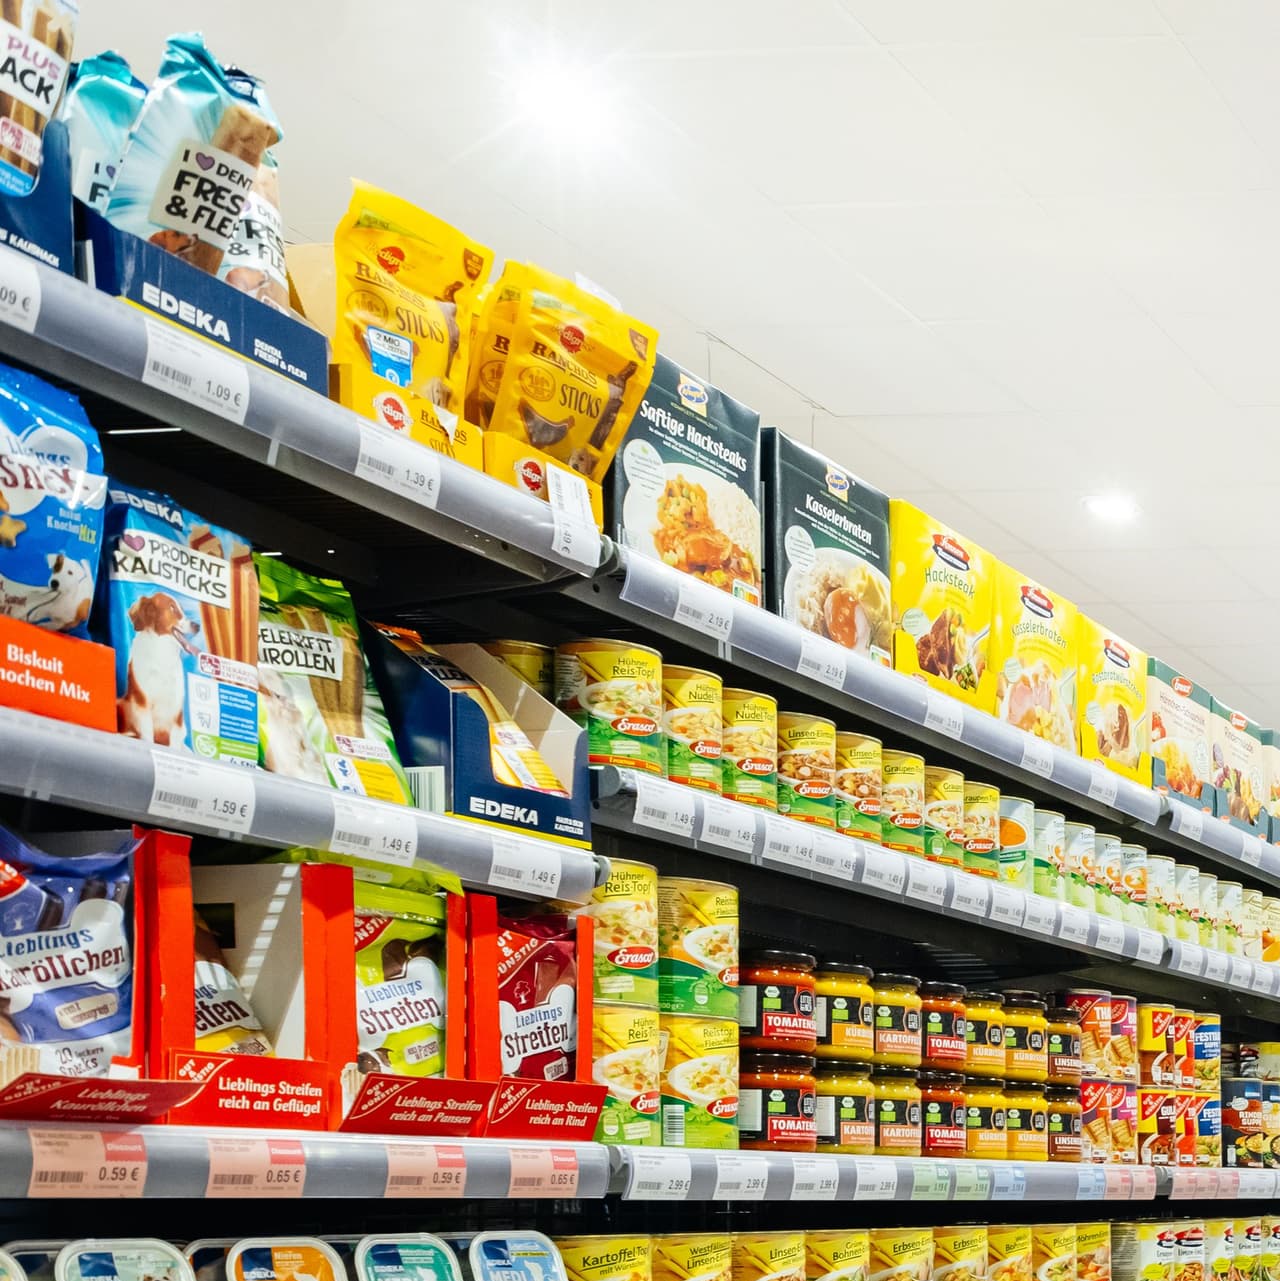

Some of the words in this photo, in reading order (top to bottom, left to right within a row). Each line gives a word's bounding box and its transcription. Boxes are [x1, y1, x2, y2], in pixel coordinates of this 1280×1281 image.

[7, 34, 60, 80] PLUS
[141, 282, 231, 340] EDEKA
[395, 306, 444, 343] STICKS
[205, 380, 231, 405] 1.09
[559, 386, 600, 419] STICKS
[639, 401, 684, 437] Saftige
[686, 428, 747, 472] Hacksteaks
[110, 490, 185, 528] EDEKA
[805, 495, 872, 546] Kasselerbraten
[150, 538, 225, 578] PRODENT
[112, 551, 228, 600] KAUSTICKS
[924, 567, 976, 599] Hacksteak
[6, 642, 64, 674] Biskuit
[0, 671, 54, 695] nochen
[60, 680, 91, 703] Mix
[617, 718, 656, 735] Erasco
[212, 800, 236, 816] 1.59
[239, 804, 248, 818] €
[469, 797, 539, 825] EDEKA
[610, 871, 644, 883] Hühner
[614, 949, 654, 966] Erasco
[365, 980, 422, 1004] Lieblings
[360, 996, 441, 1036] Streifen
[515, 1005, 563, 1028] Lieblings
[504, 1024, 570, 1058] Streifen
[219, 1077, 275, 1095] Lieblings
[278, 1079, 323, 1097] Streifen
[218, 1095, 251, 1110] reich
[254, 1098, 269, 1110] an
[273, 1098, 321, 1116] Geflügel
[391, 1110, 419, 1122] reich
[421, 1112, 434, 1122] an
[438, 1113, 471, 1126] Pansen
[397, 1096, 441, 1111] Lieblings
[445, 1099, 482, 1113] Streifen
[526, 1098, 563, 1113] Lieblings
[565, 1102, 598, 1117] Streifen
[529, 1112, 552, 1125] reich
[567, 1114, 587, 1127] Rind
[99, 1165, 126, 1182] 0.59
[130, 1165, 140, 1182] €
